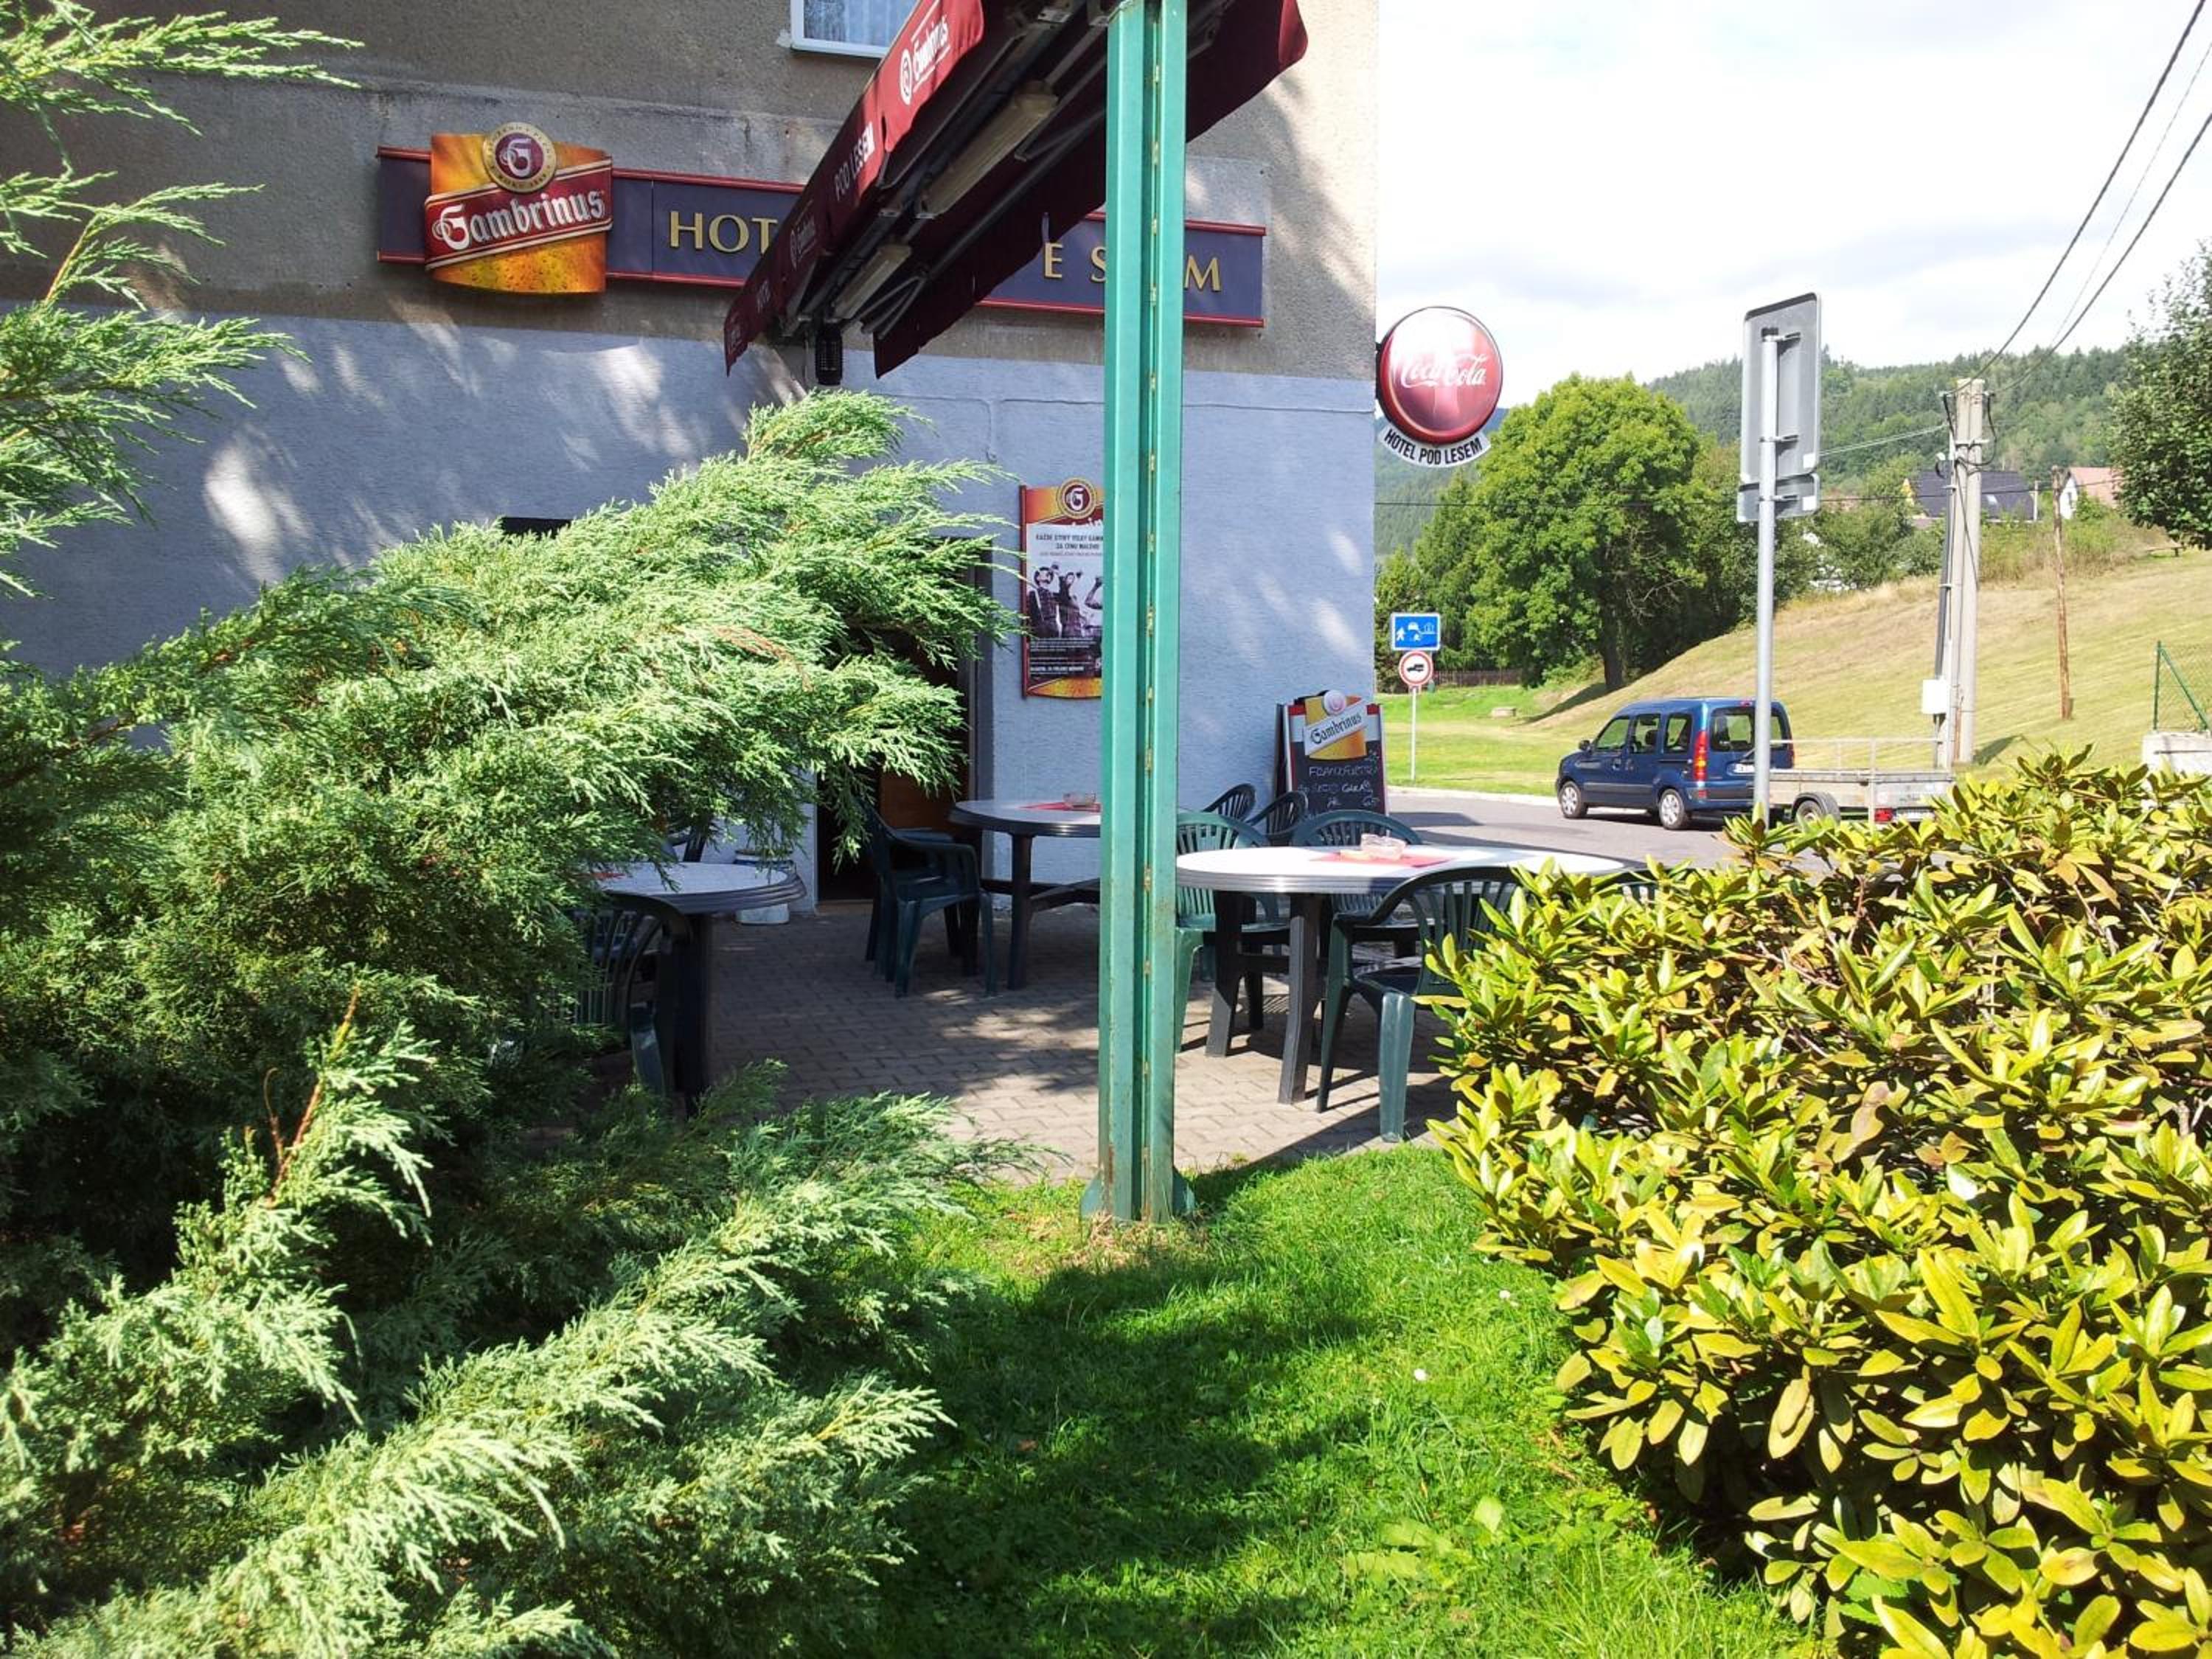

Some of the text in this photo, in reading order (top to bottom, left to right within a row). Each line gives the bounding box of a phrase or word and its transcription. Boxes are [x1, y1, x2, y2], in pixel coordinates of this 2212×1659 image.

[431, 190, 606, 251] Gambrinus
[669, 210, 779, 254] HOT
[1384, 428, 1484, 465] HOTEL POD LESEM
[1310, 712, 1363, 745] Gambrinus
